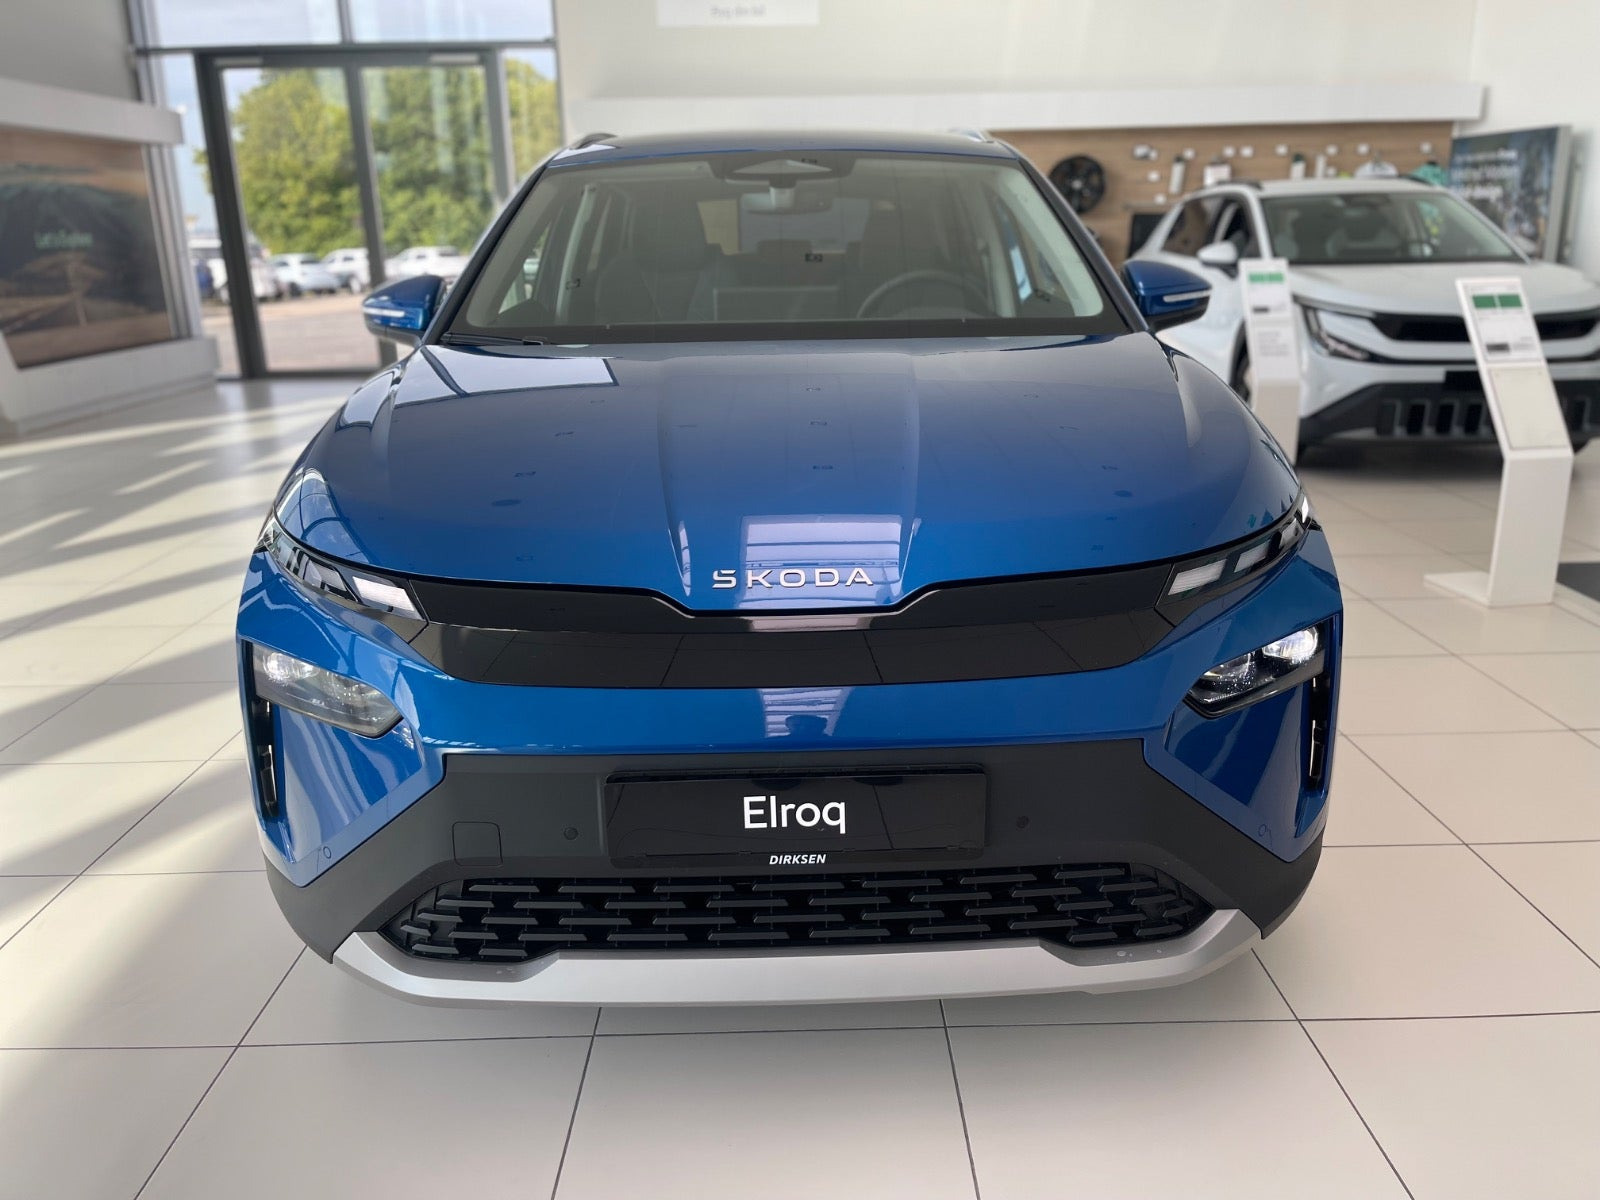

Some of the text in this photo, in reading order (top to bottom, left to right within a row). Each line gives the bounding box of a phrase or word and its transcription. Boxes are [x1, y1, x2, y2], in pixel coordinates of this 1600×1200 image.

[711, 567, 874, 589] SKODA
[742, 795, 847, 834] Elroq
[768, 853, 827, 865] DIRKSEN
